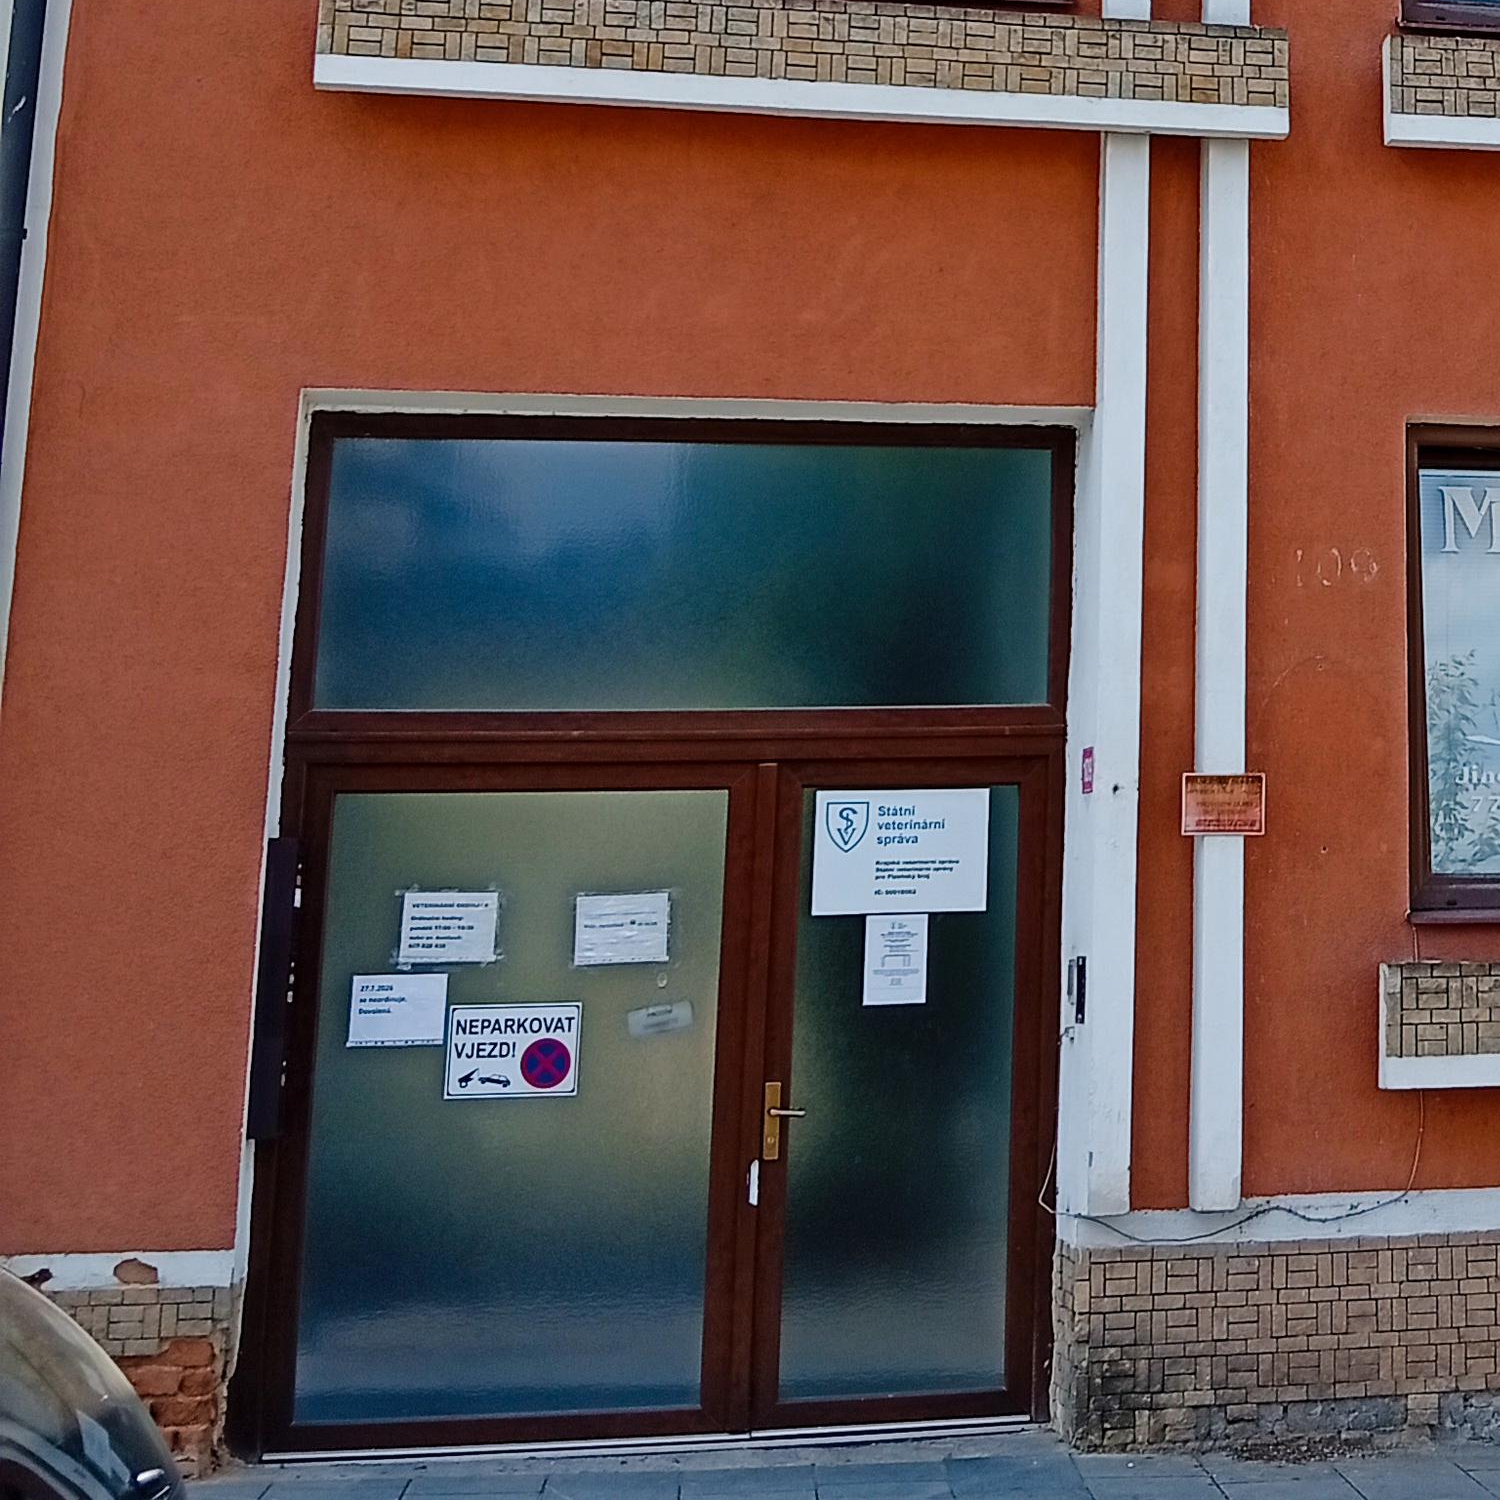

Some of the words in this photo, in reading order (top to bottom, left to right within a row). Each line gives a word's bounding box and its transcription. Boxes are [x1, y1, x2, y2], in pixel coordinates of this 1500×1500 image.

[877, 805, 916, 817] Státní
[877, 818, 946, 830] veterinární
[876, 833, 919, 847] správa
[455, 1016, 576, 1036] NEPARKOVAT
[454, 1041, 517, 1059] VJEZD!
